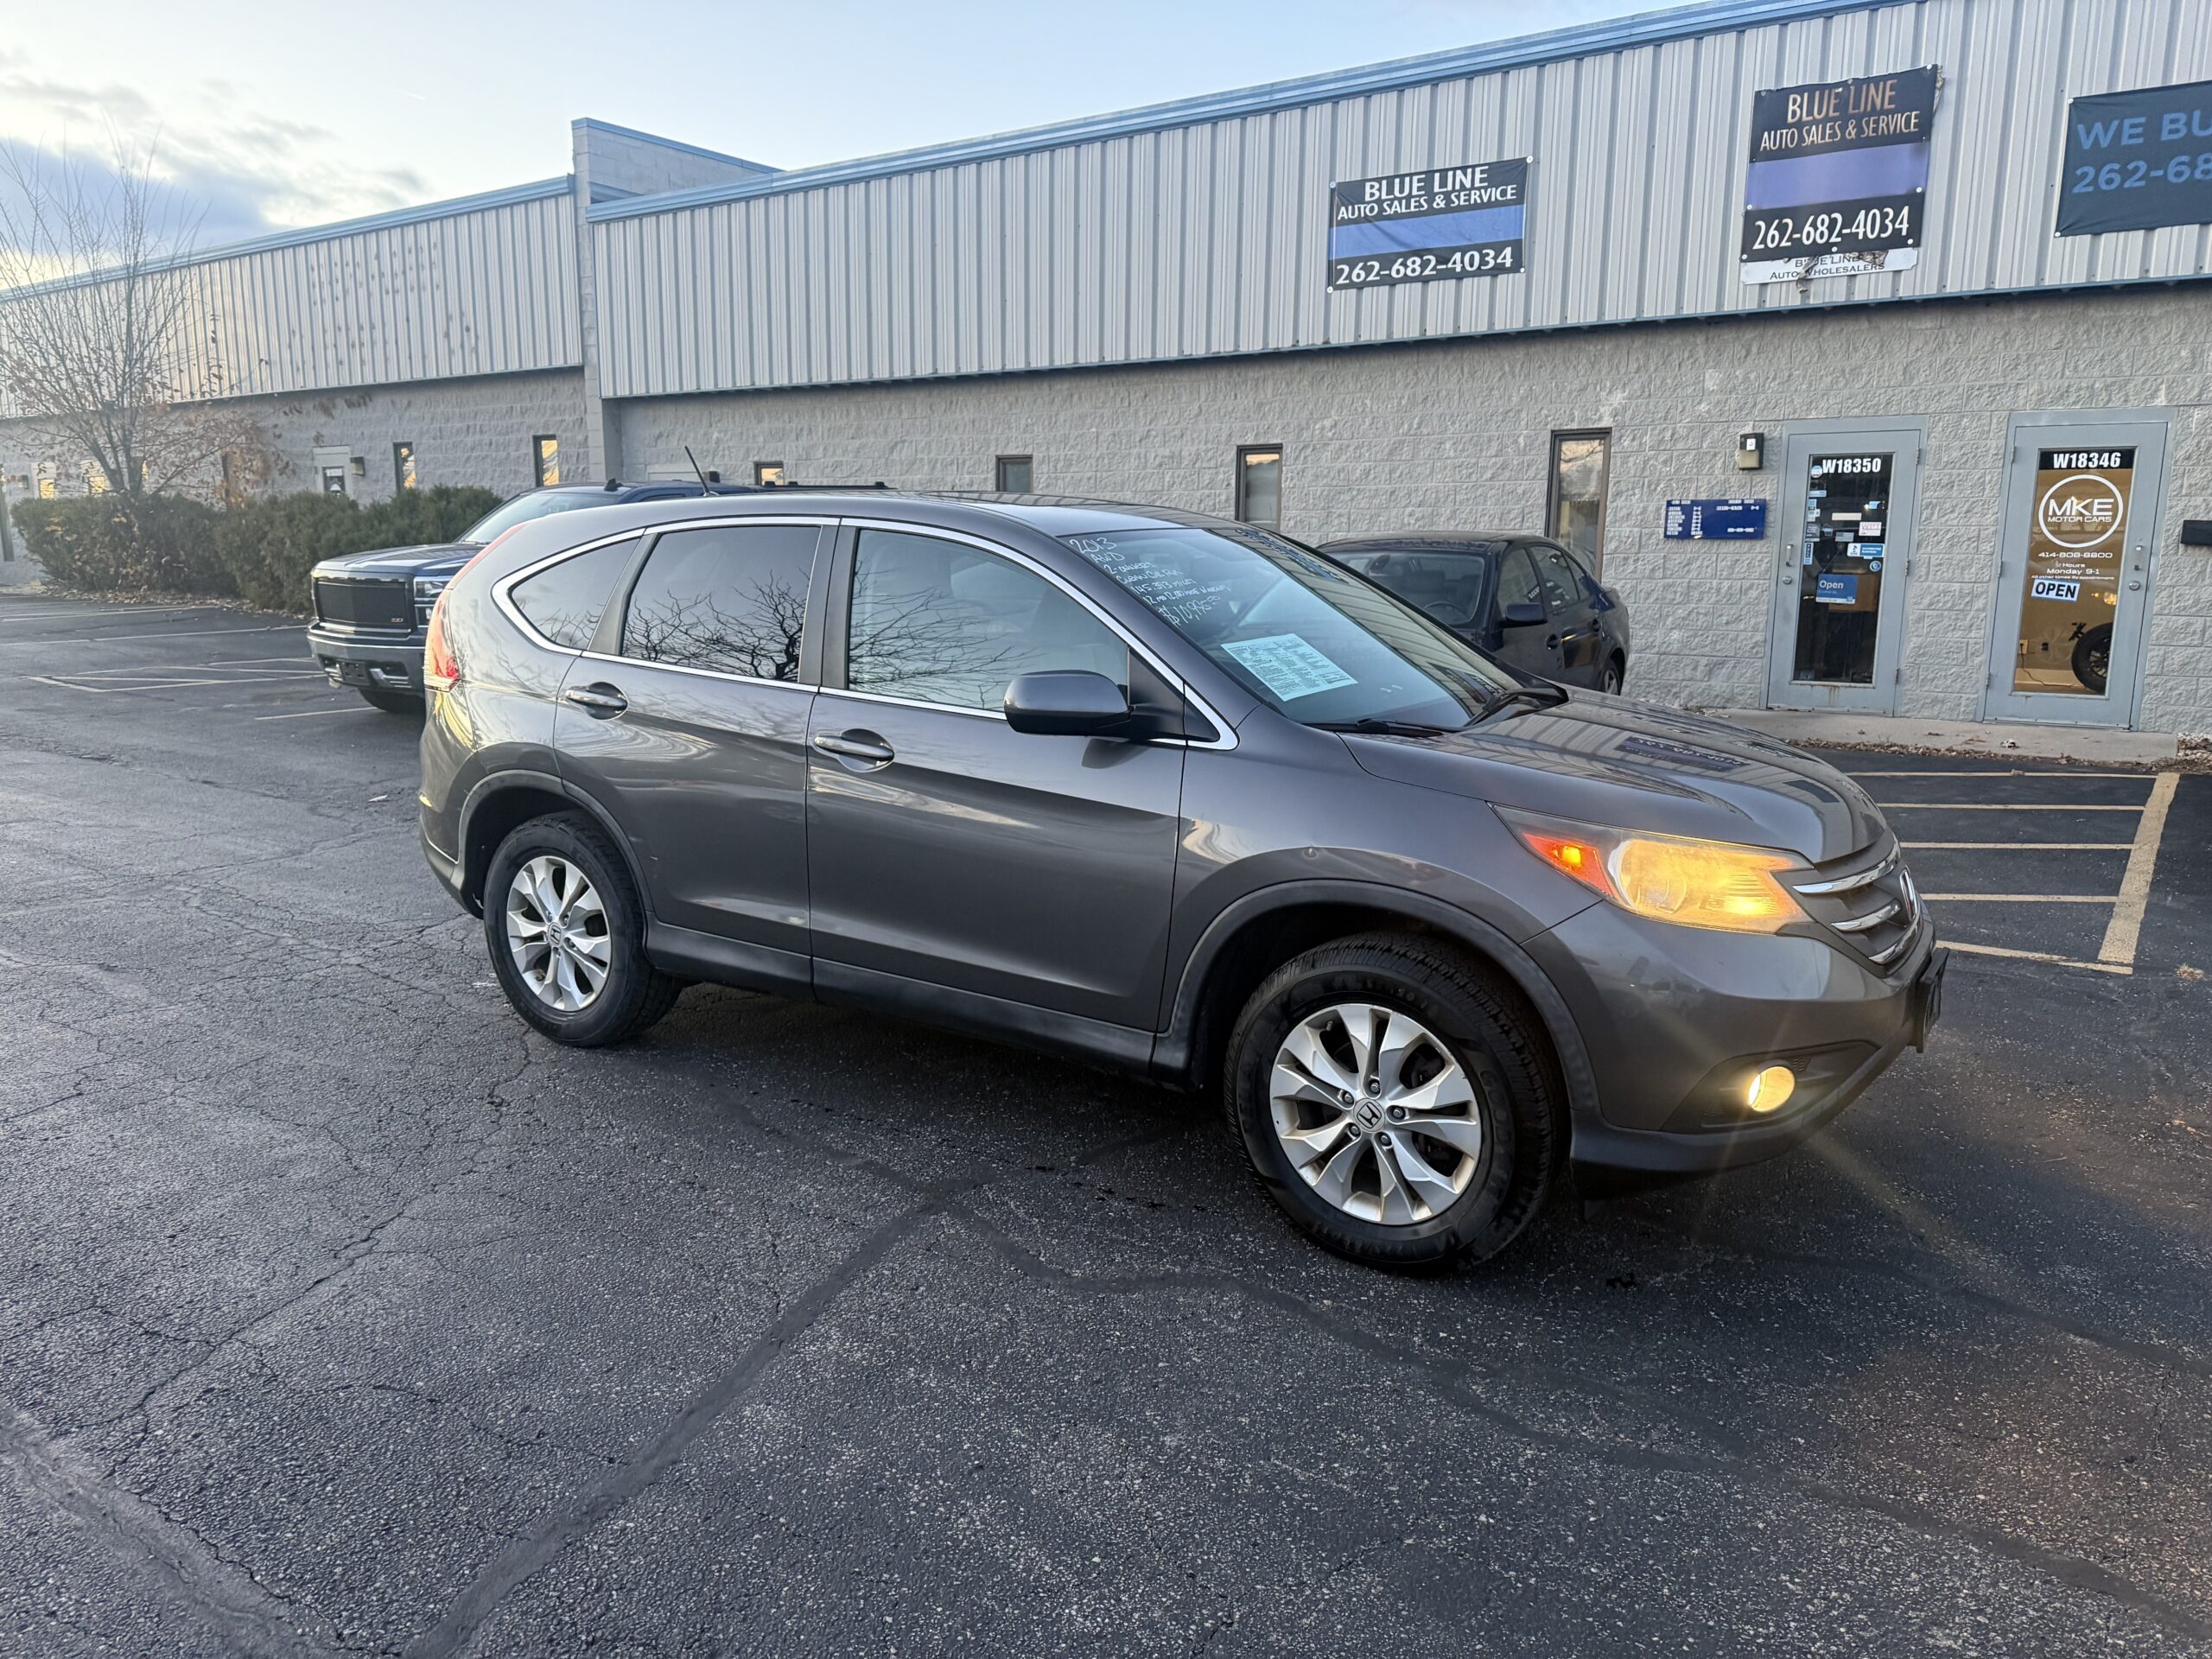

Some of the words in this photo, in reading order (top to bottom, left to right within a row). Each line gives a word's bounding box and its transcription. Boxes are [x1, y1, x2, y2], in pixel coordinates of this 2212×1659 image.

[1787, 88, 1840, 124] BLUE
[1848, 79, 1898, 114] LINE
[1759, 128, 1797, 152] AUTO
[1802, 121, 1841, 146] SALES
[1846, 119, 1857, 139] &
[1860, 111, 1920, 138] SERVICE
[2077, 117, 2146, 150] WE
[1365, 175, 1426, 202] BLUE
[1433, 166, 1489, 193] LINE
[1338, 202, 1378, 220] AUTO
[1382, 196, 1428, 215] SALES
[1433, 195, 1446, 209] &
[1450, 185, 1517, 207] SERVICE
[1752, 206, 1910, 250] 262-682-4034
[1336, 247, 1514, 285] 262-682-4034
[1795, 257, 1827, 268] BE
[1770, 270, 1799, 280] AUTO
[1822, 458, 1882, 474] W18350
[2053, 452, 2121, 468] W18346
[2048, 498, 2115, 516] MKE
[1070, 537, 1116, 554] 2013
[1090, 551, 1125, 563] AWD
[1820, 581, 1844, 589] Open
[2035, 582, 2076, 598] OPEN
